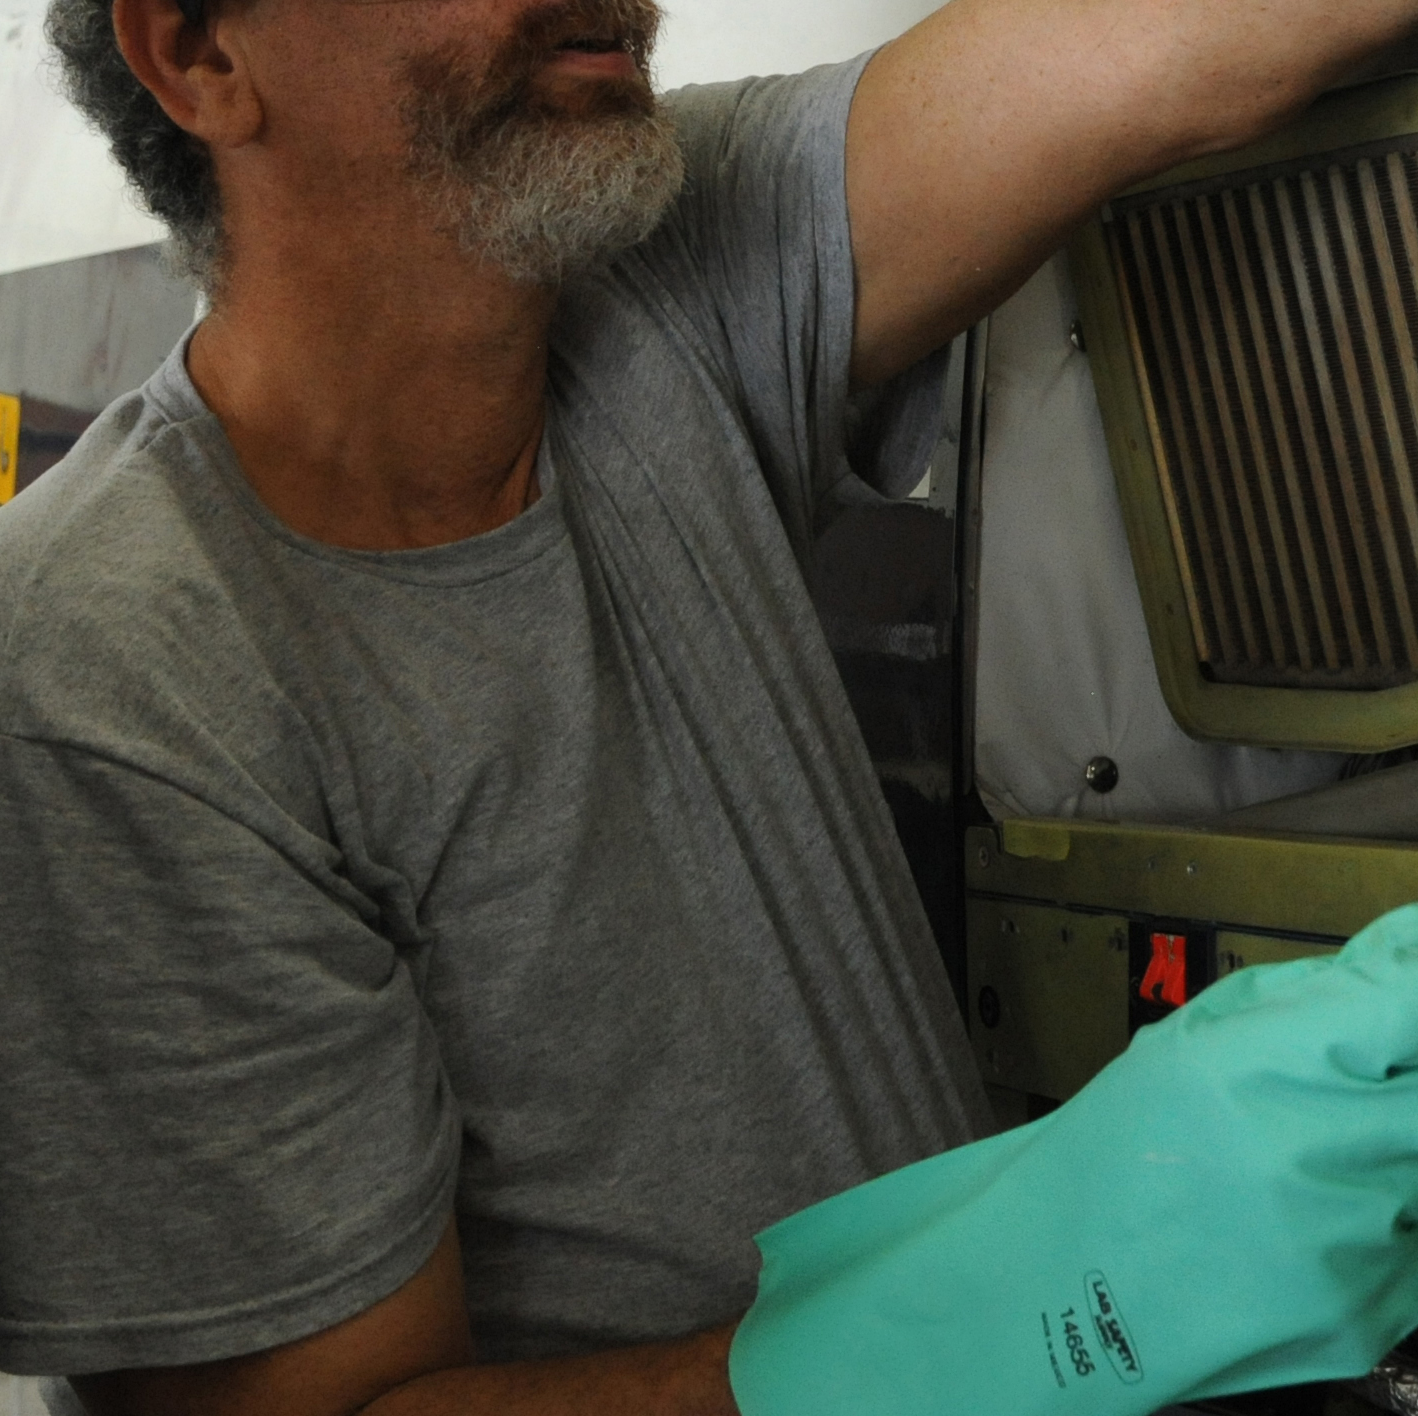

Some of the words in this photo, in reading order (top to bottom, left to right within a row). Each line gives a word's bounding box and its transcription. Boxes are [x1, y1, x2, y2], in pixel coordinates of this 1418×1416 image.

[1061, 1307, 1096, 1376] 14655
[1093, 1281, 1111, 1314] LAB
[1106, 1319, 1137, 1371] SAFETY
